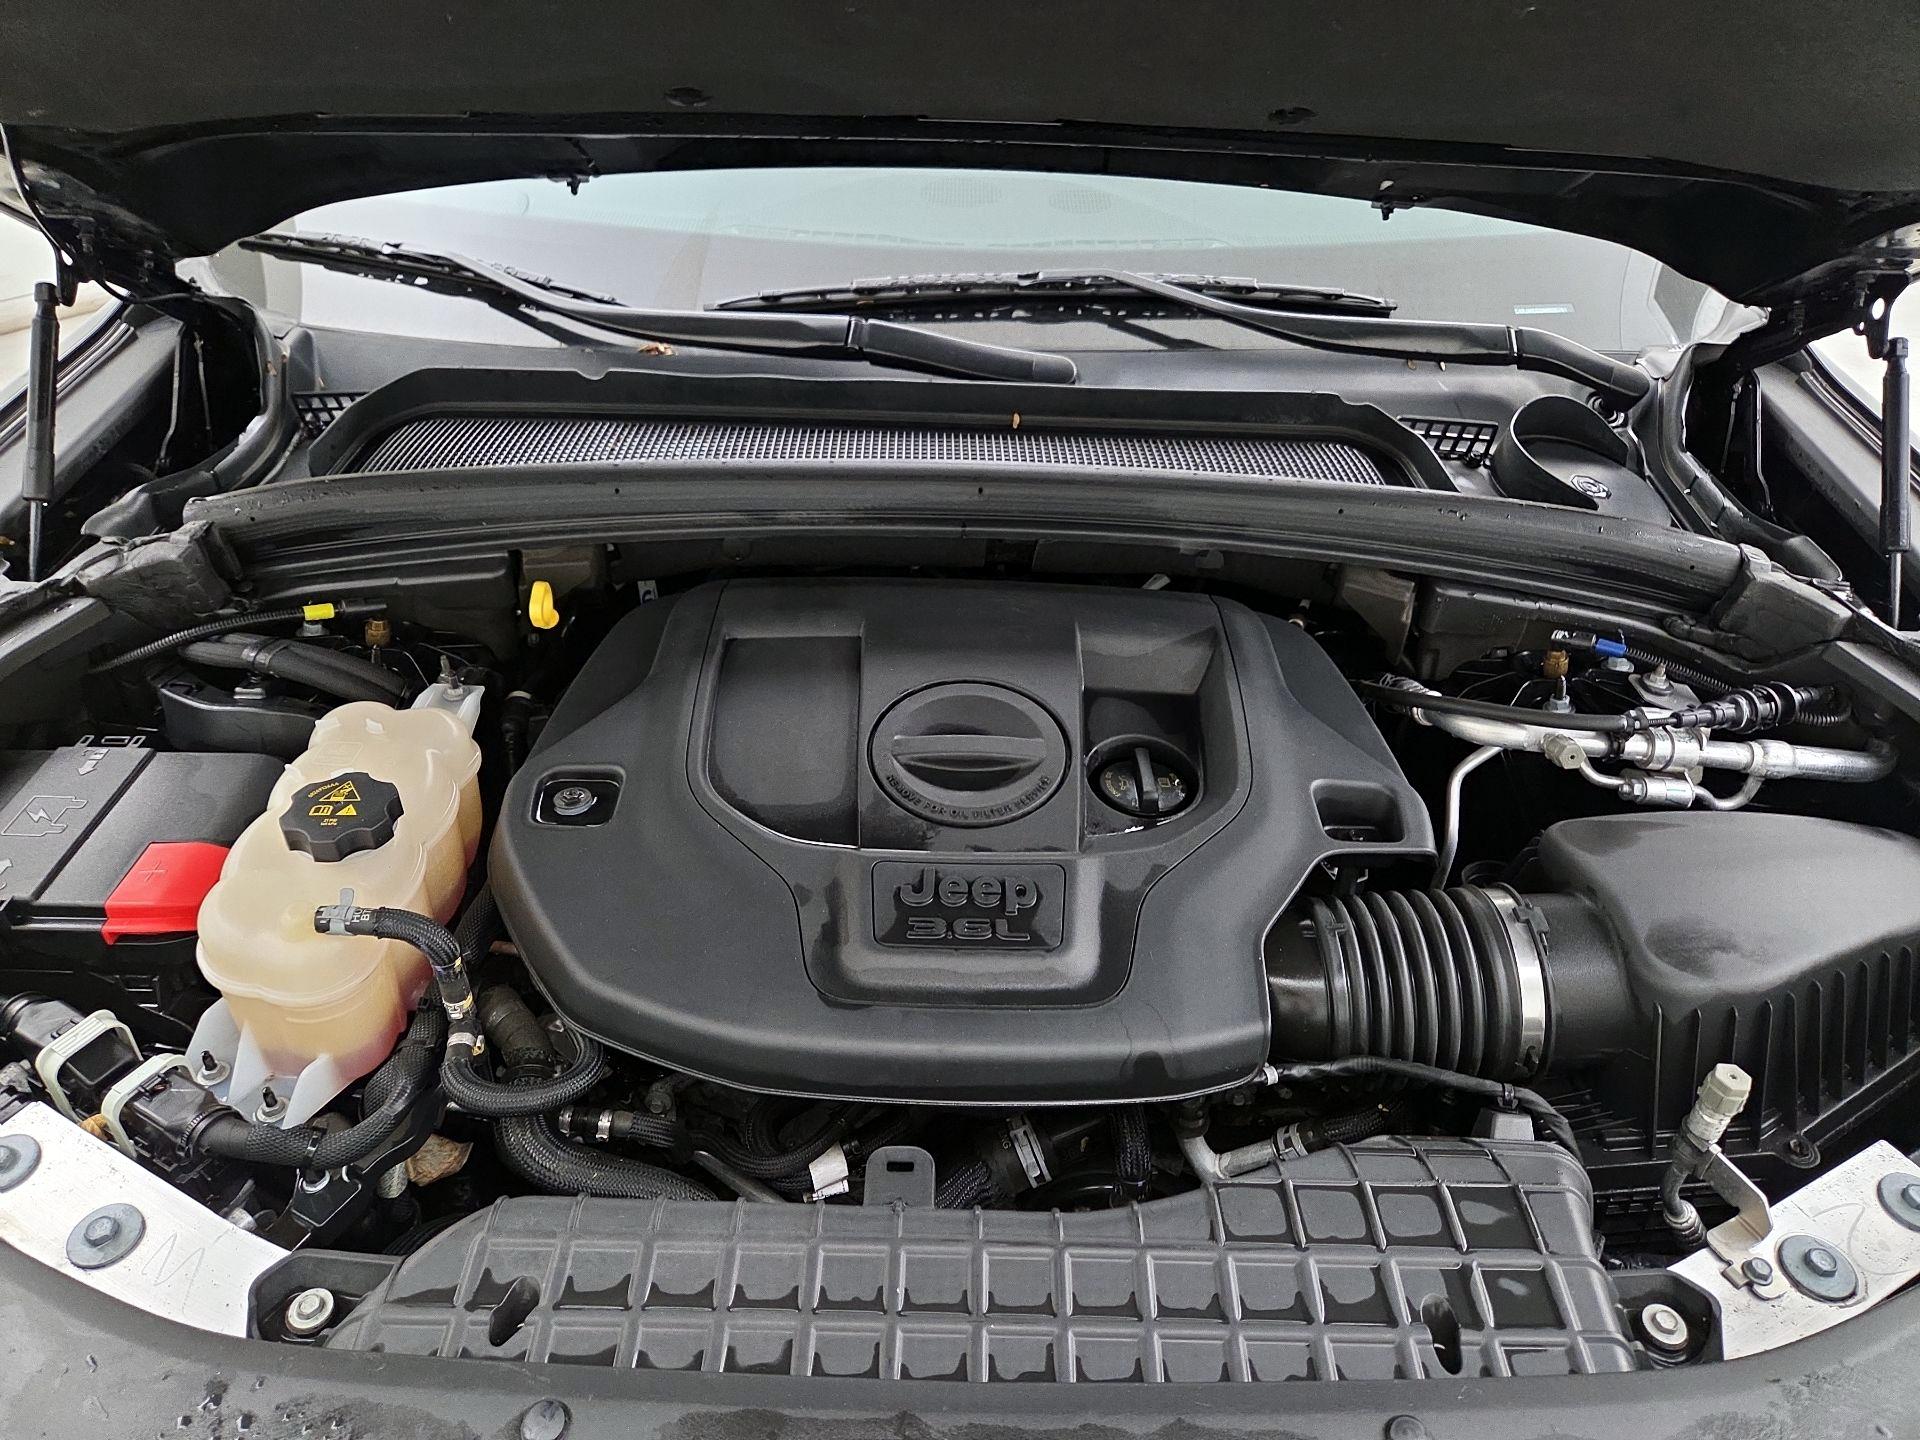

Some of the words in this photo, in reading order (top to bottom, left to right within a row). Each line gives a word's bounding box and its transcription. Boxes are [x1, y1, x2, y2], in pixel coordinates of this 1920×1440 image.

[886, 775, 921, 806] REMOVE
[923, 800, 947, 816] FOR
[950, 806, 969, 820] OIL
[973, 802, 1013, 819] FILTER
[900, 866, 1037, 916] Jeep
[906, 917, 1031, 941] 3.6L
